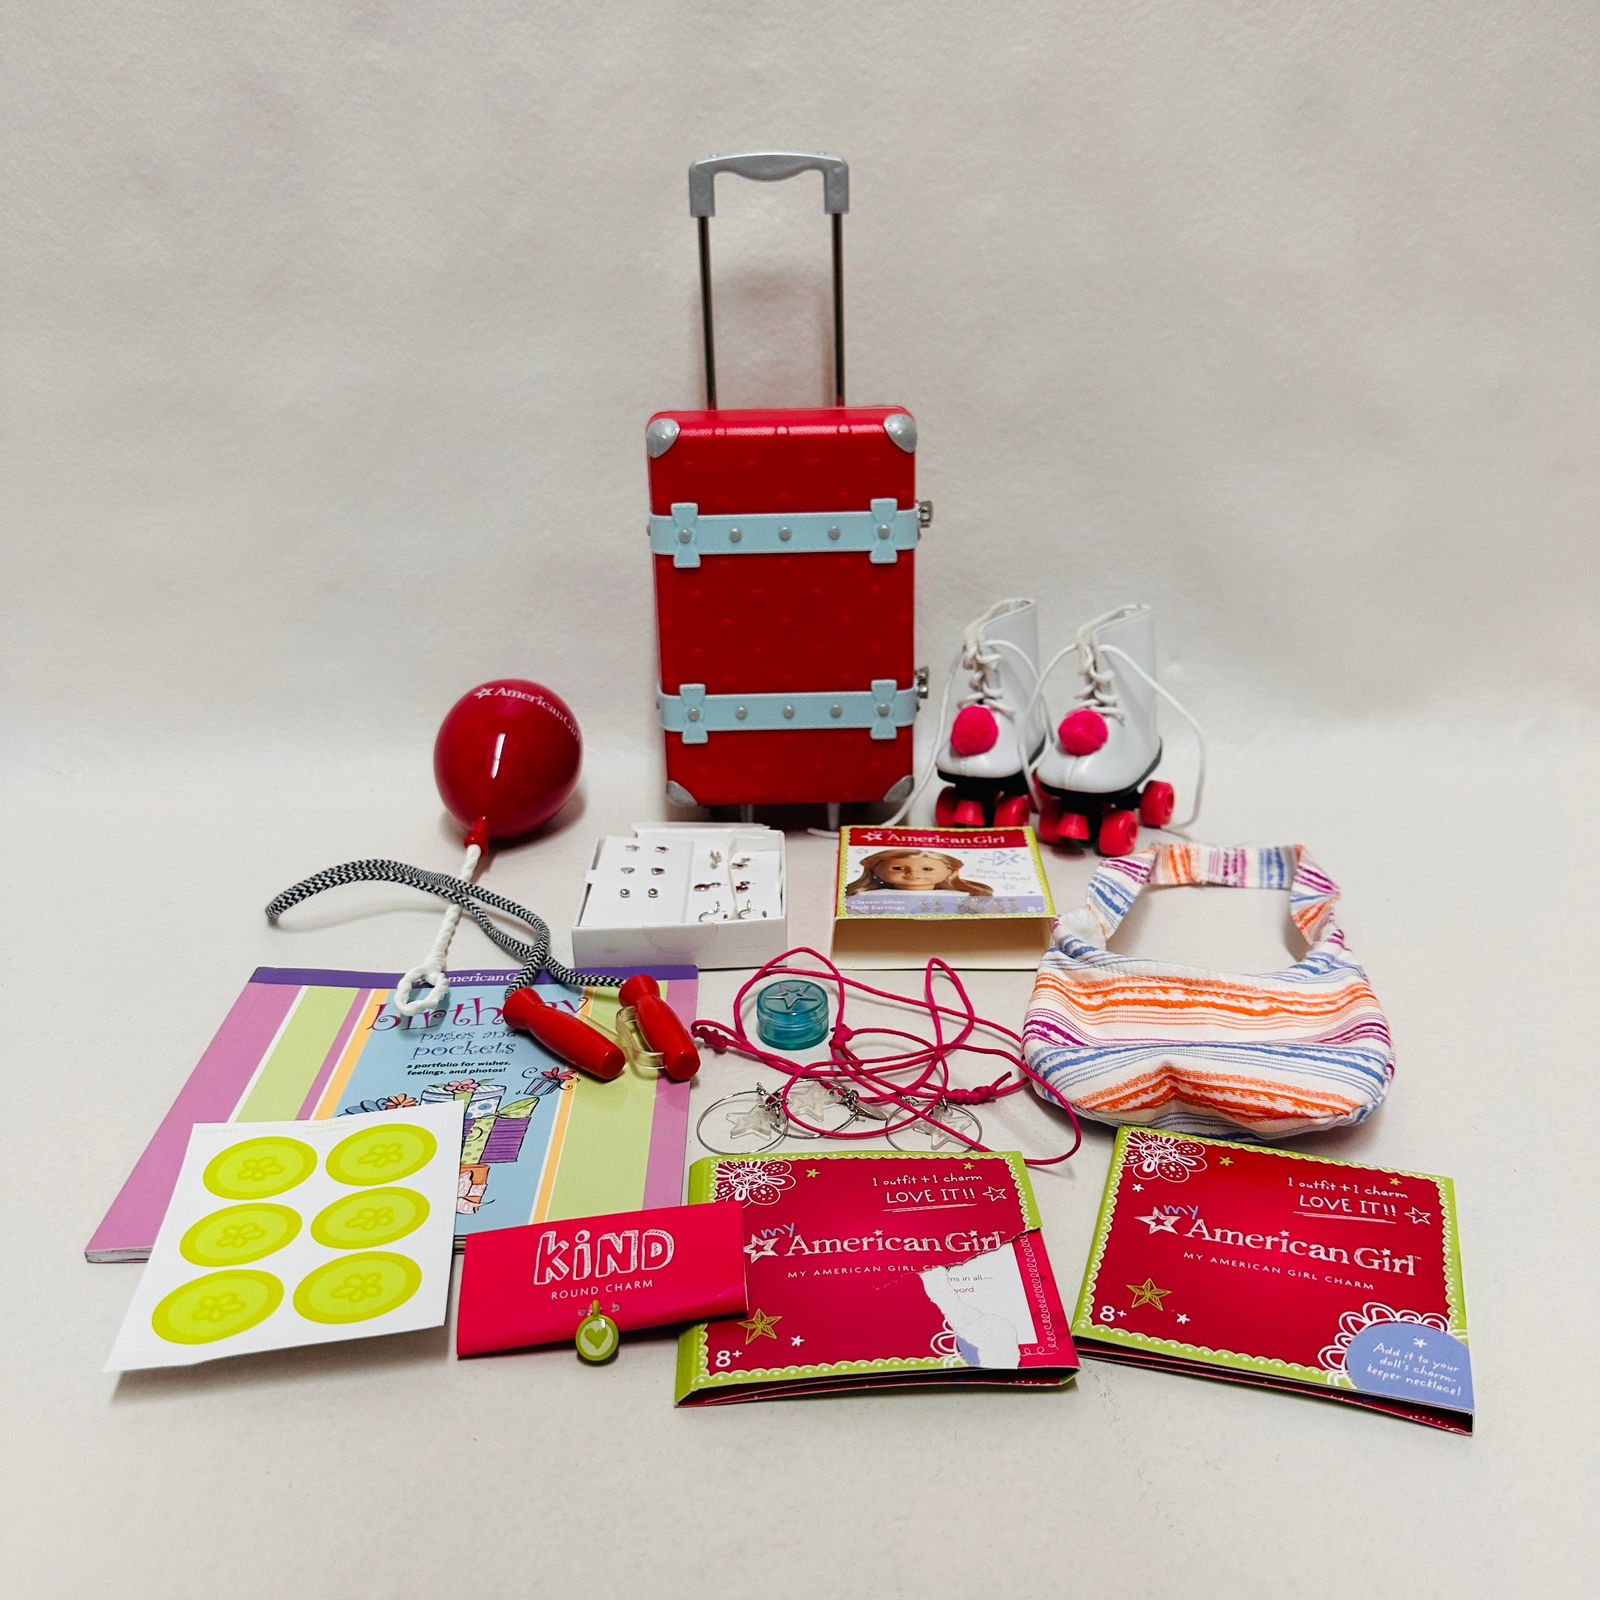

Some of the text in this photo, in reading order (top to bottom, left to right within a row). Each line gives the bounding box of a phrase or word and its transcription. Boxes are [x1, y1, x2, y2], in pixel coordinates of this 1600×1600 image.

[447, 972, 504, 983] merican
[366, 996, 589, 1031] brthy
[420, 1030, 476, 1043] pages
[410, 1040, 517, 1060] pockets
[414, 1061, 459, 1069] portfolio
[468, 1067, 507, 1075] photos!
[872, 1177, 878, 1186] 1
[883, 1174, 917, 1186] outfit
[943, 1173, 982, 1183] charm
[1288, 1176, 1293, 1187] 1
[1299, 1179, 1336, 1191] outfit
[1364, 1185, 1408, 1198] charm
[886, 1187, 975, 1203] LOVE IT!!
[1164, 1204, 1198, 1220] my
[1300, 1194, 1397, 1216] LOVE IT!!
[760, 1222, 795, 1239] my
[784, 1229, 944, 1257] American
[1183, 1218, 1350, 1265] American
[813, 1265, 881, 1276] AMERICAN
[888, 1264, 917, 1272] GIRL
[1183, 1252, 1374, 1290] MY AMERICAN GIRL CHARM
[551, 1279, 653, 1300] ROUND CHARM
[1373, 1342, 1460, 1373] Add it to your
[1379, 1356, 1409, 1371] doll's
[1366, 1363, 1462, 1397] keeper necklace!
